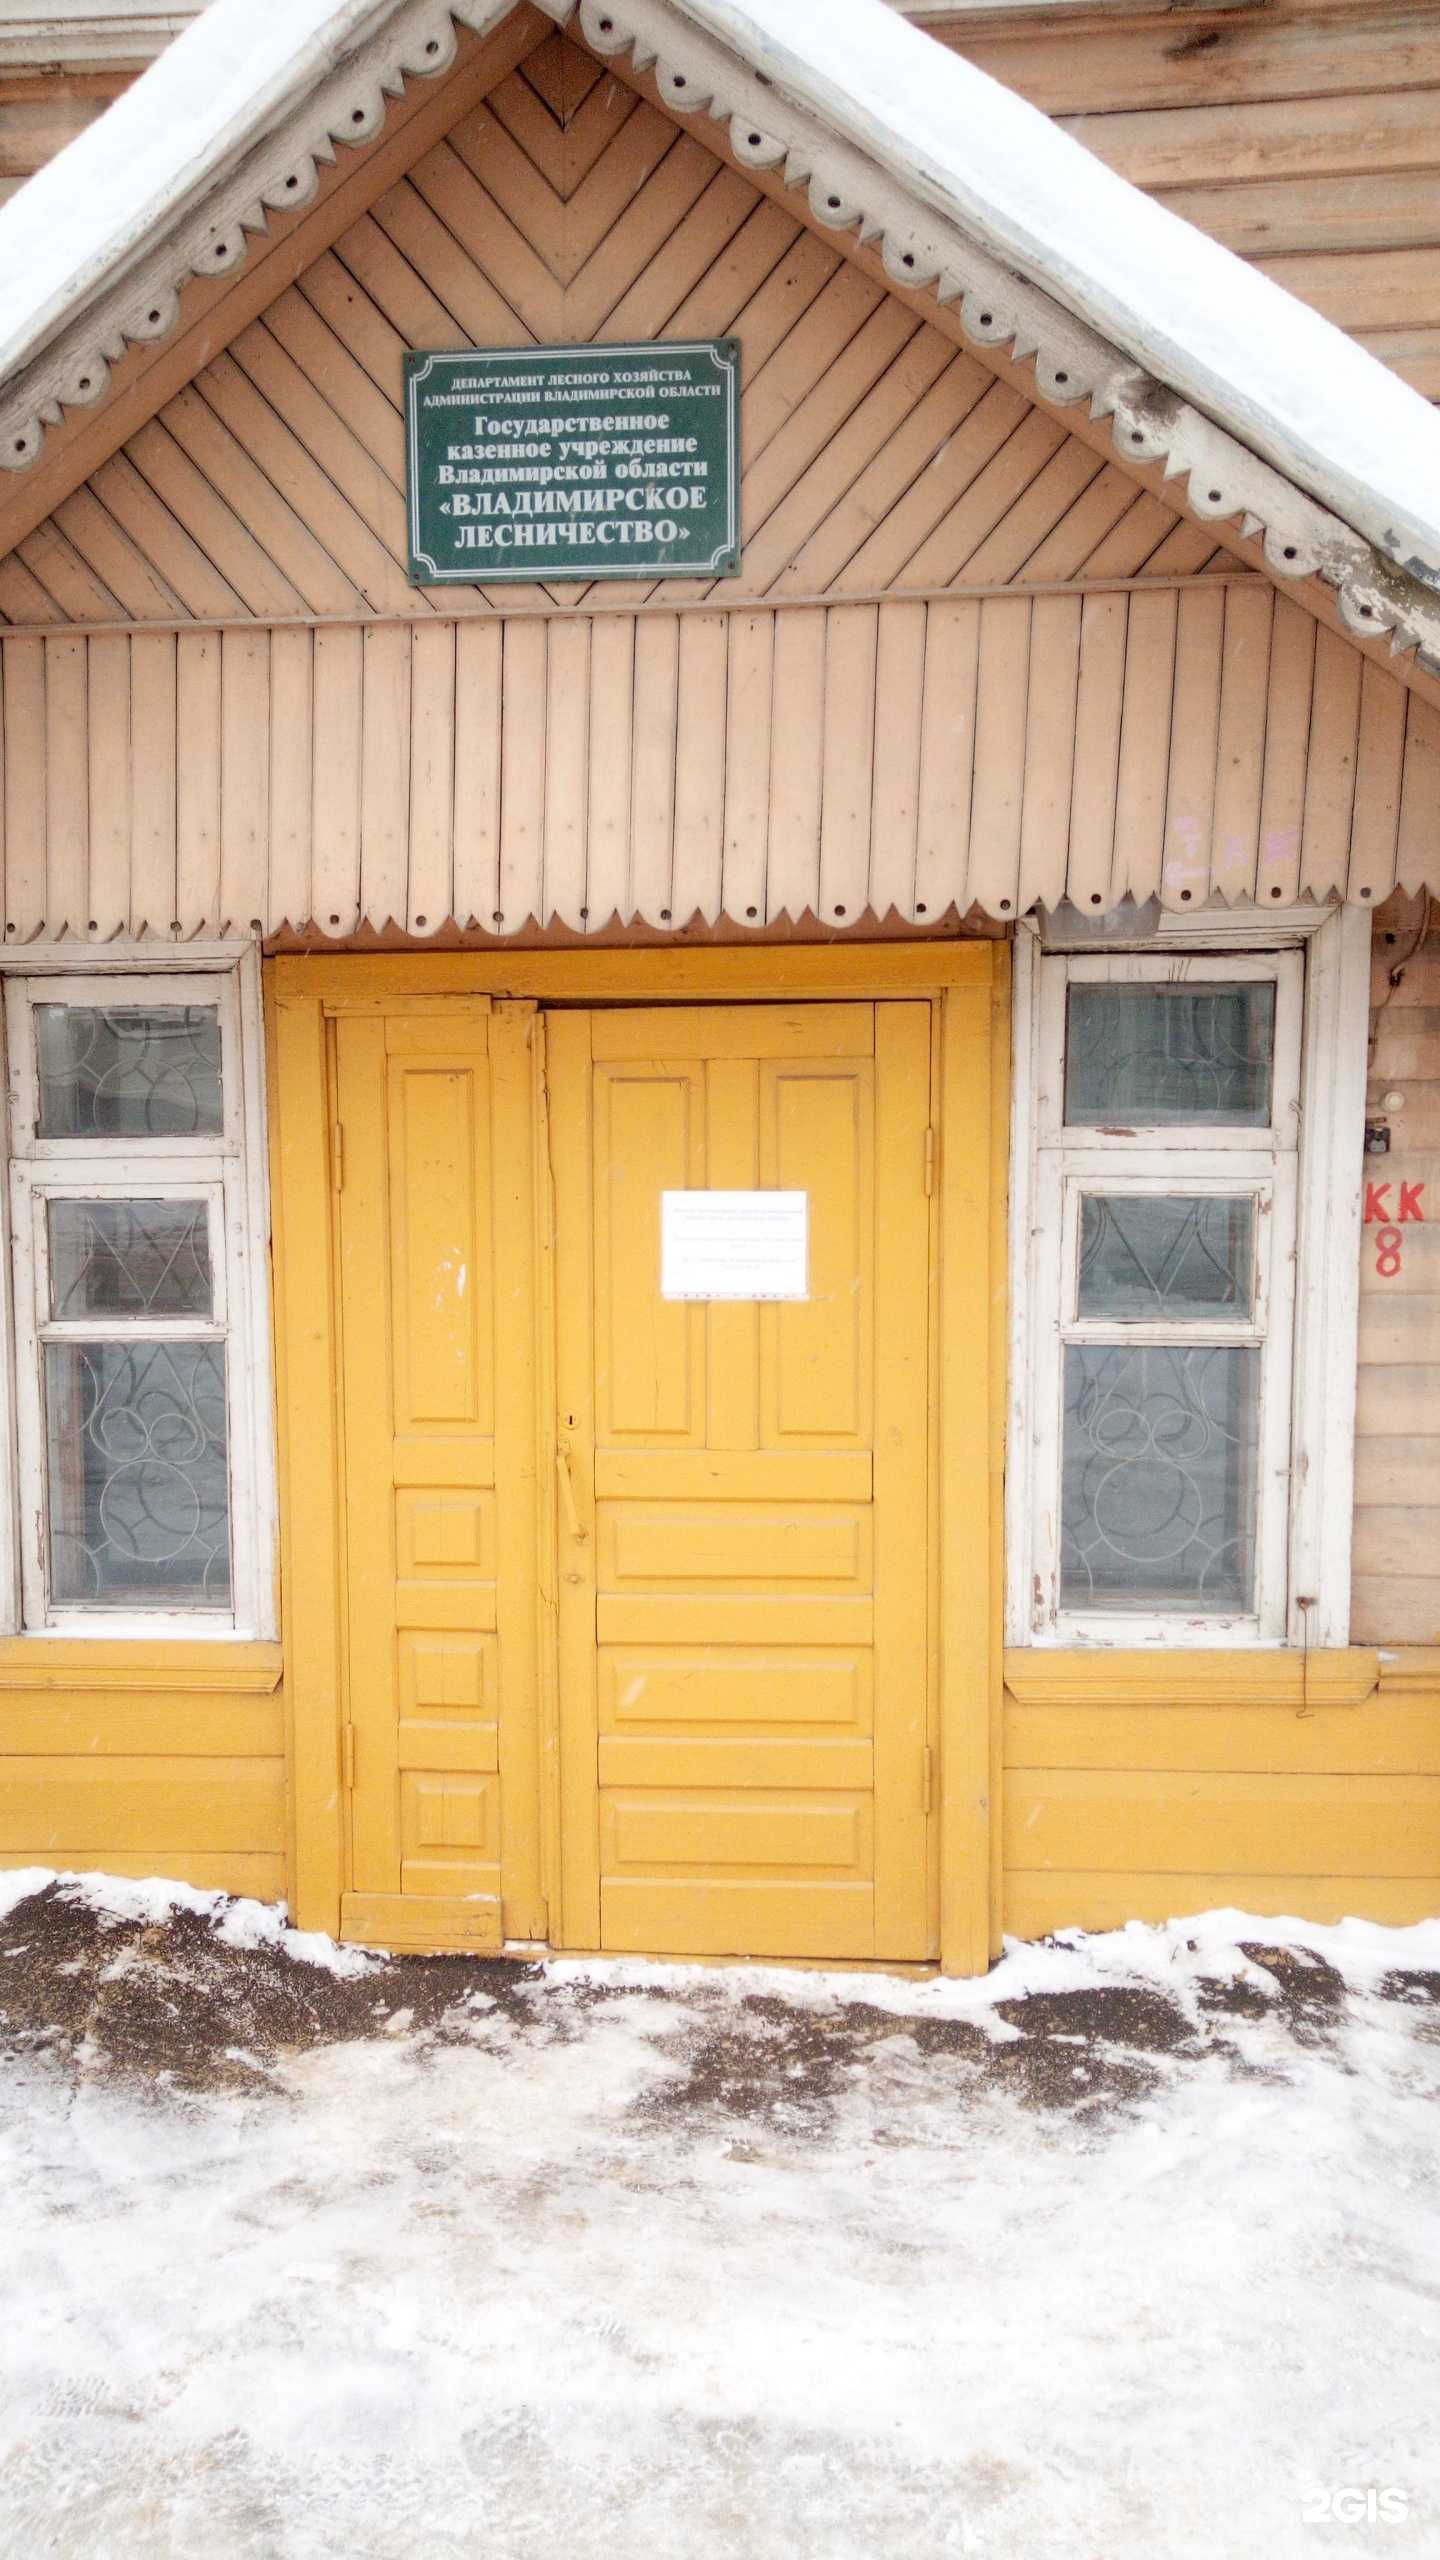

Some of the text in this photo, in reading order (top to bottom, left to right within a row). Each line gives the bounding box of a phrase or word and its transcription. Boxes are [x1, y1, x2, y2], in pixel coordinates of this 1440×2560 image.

[451, 369, 691, 391] ДЕПАРТАМЕНТ ЛЕСНОГО ХОЗЯЙСТВА
[424, 384, 721, 407] АДМИНИСТРАЦИИ ВЛАДИМИРСКОЙ ОБЛАСТИ
[474, 414, 669, 438] Государственное
[447, 436, 698, 461] казенное учреждение
[439, 458, 708, 485] Владимирской области
[440, 486, 707, 518] «ВЛАДИМИРСКОЕ
[454, 519, 690, 548] ЛЕСНИЧЕСТВО»
[1375, 1226, 1402, 1278] 8
